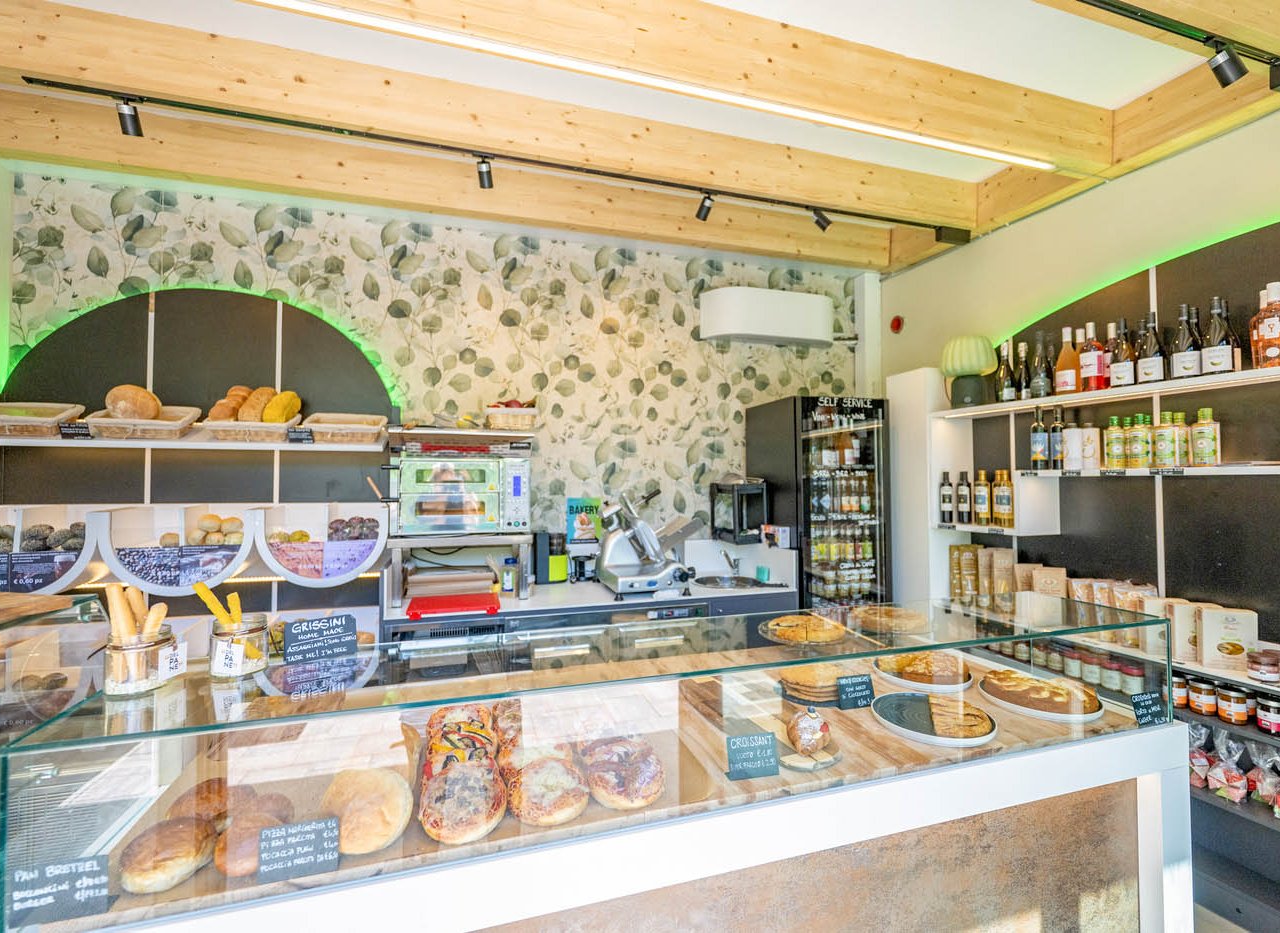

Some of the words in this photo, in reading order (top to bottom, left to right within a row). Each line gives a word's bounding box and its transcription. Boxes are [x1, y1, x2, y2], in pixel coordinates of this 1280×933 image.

[817, 396, 838, 407] SELF
[842, 398, 873, 408] SERVICE
[569, 505, 600, 515] BAKERY
[291, 616, 346, 633] GRISSINI
[298, 632, 320, 640] HOME
[731, 735, 773, 749] CROISSANT
[261, 828, 286, 839] PIZZA
[14, 869, 39, 882] PAN
